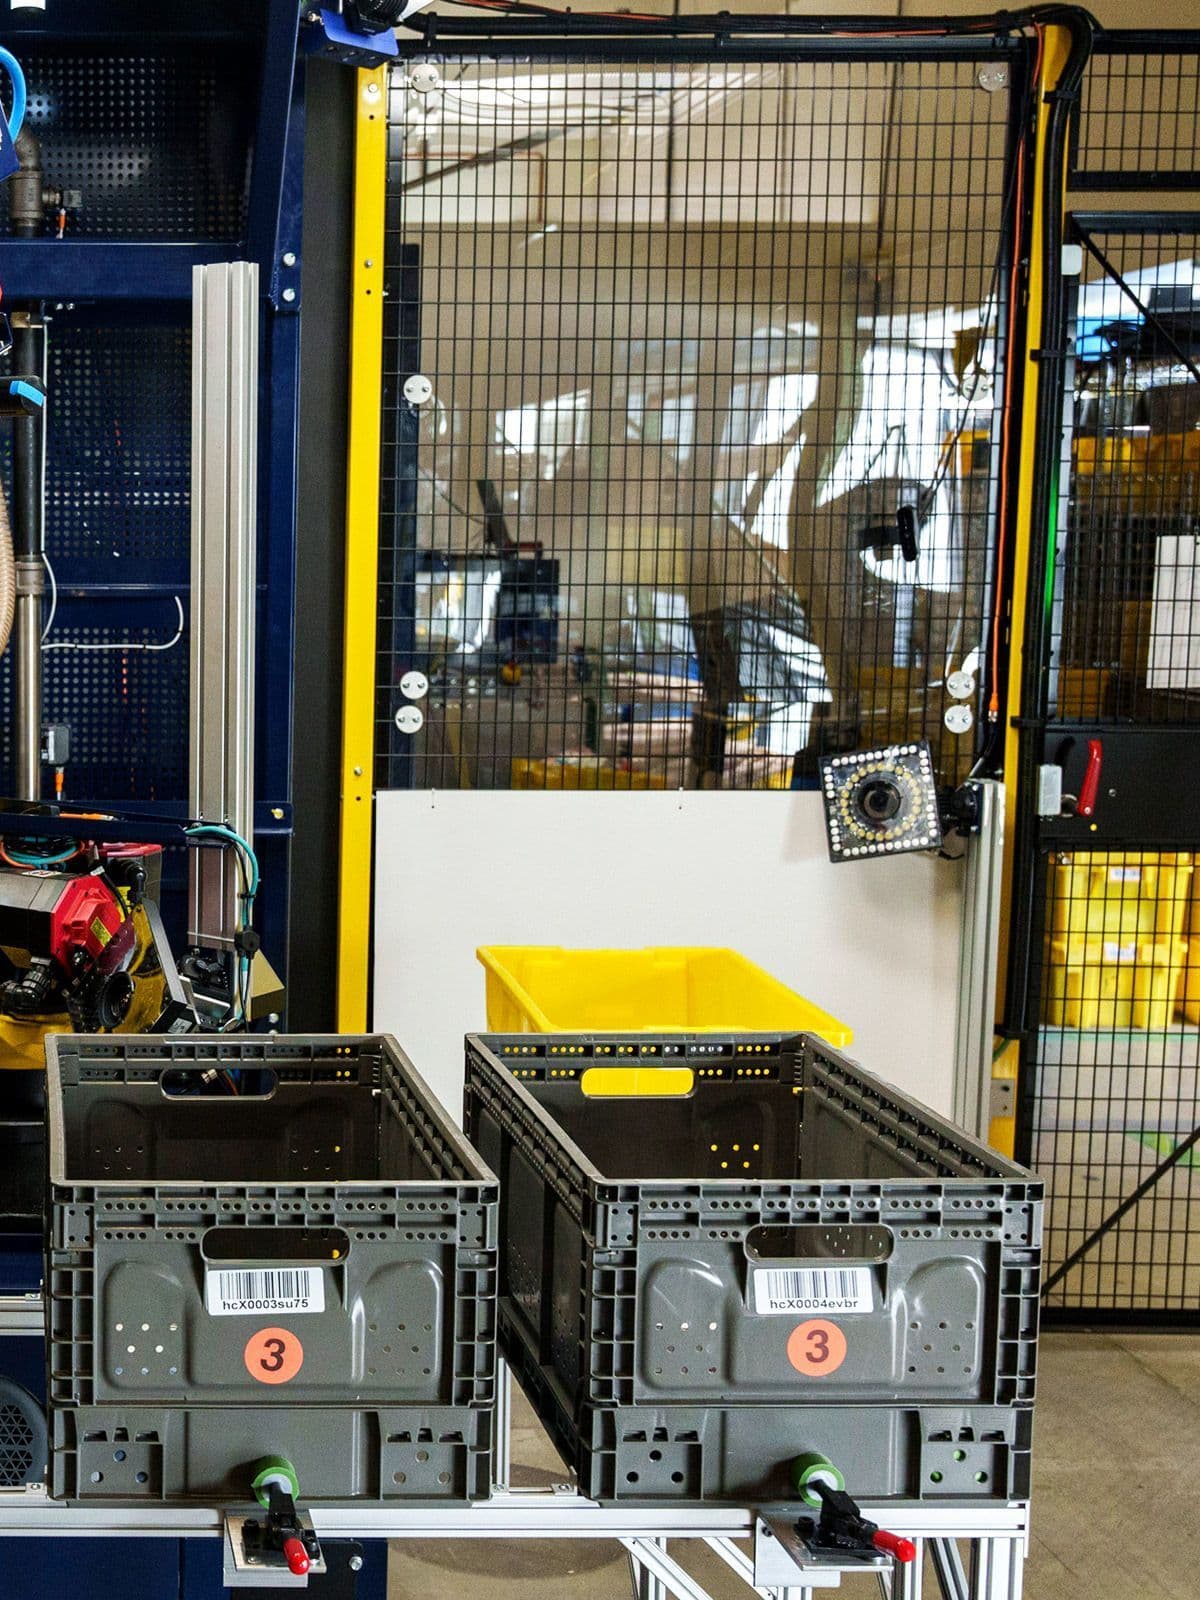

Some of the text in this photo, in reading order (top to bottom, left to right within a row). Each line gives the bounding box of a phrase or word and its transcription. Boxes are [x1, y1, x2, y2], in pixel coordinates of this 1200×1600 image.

[223, 1299, 309, 1310] hcX0003su75
[770, 1299, 858, 1309] hcX0004evbr
[260, 1338, 286, 1372] 3
[805, 1329, 830, 1363] 3
